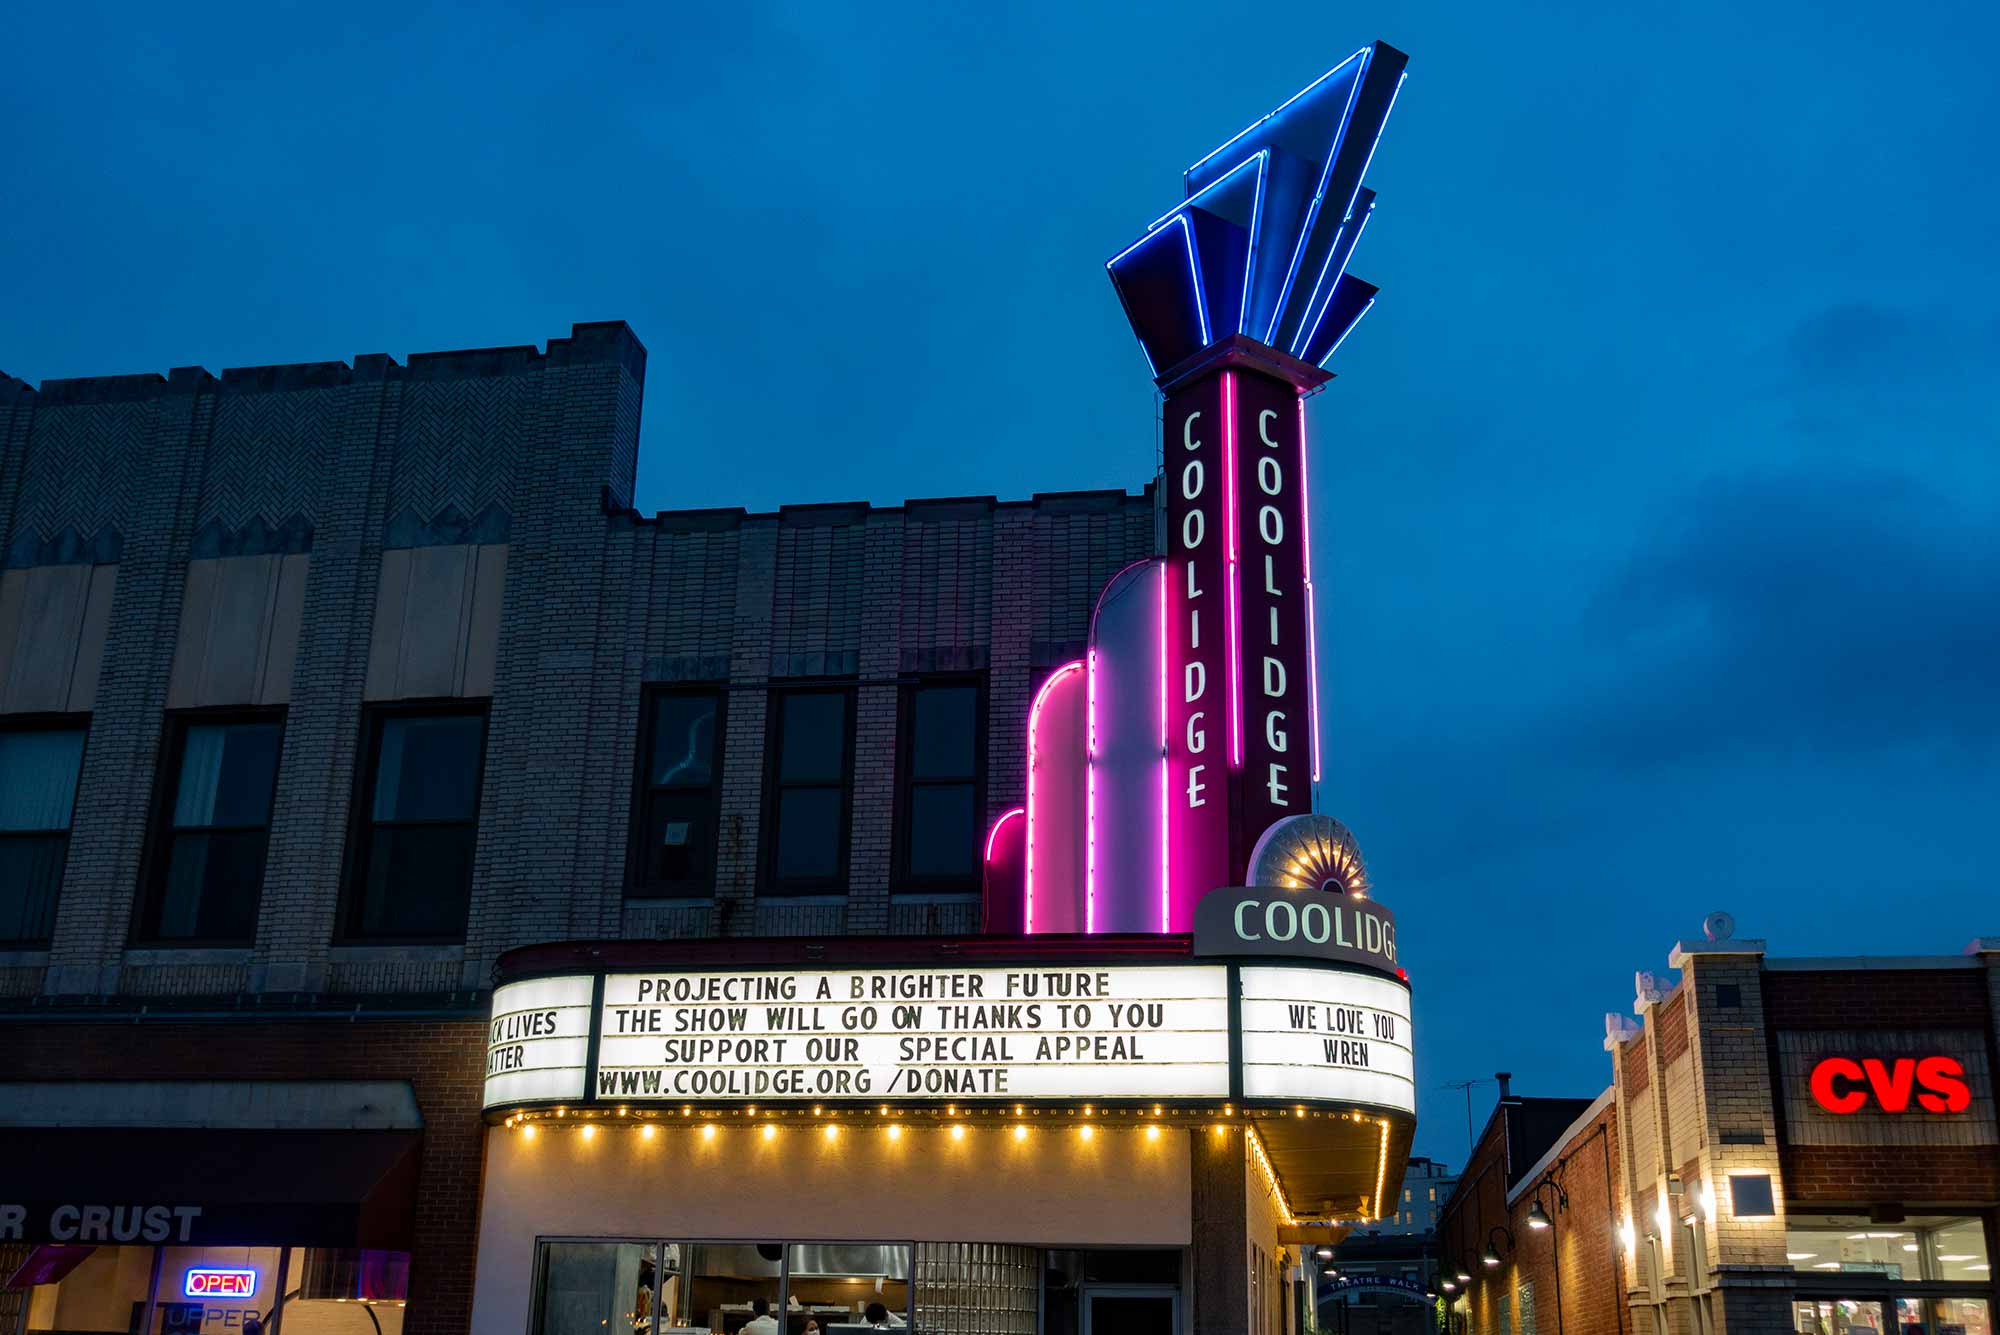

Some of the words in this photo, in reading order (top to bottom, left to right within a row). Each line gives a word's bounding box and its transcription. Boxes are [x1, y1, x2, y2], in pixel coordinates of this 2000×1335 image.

[1182, 411, 1206, 809] COOLIDGE
[1257, 408, 1289, 807] COOLIDGE
[638, 976, 797, 1002] PROJECTING
[816, 976, 832, 1000] A
[850, 974, 984, 999] BRIGHTER
[1006, 973, 1110, 998] FUTURE
[507, 1011, 557, 1040] LIVES
[616, 1009, 662, 1033] THE
[675, 1007, 748, 1032] SHOW
[766, 1007, 825, 1031] WILL
[841, 1006, 878, 1030] GO
[891, 1005, 922, 1030] ON
[937, 1004, 1042, 1029] THANKS
[1057, 1004, 1092, 1029] TO
[1108, 1003, 1164, 1028] YOU
[1288, 1004, 1318, 1030] WE
[1326, 1007, 1365, 1035] LOVE
[1373, 1012, 1396, 1041] YOU
[487, 1045, 524, 1075] ATTER
[664, 1038, 787, 1063] SUPPORT
[805, 1037, 859, 1062] OUR
[899, 1036, 1014, 1061] SPECIAL
[1035, 1035, 1144, 1060] APPEAL
[1323, 1038, 1369, 1067] WREN
[599, 1068, 871, 1096] WWW.COOLIDGE.ORG
[1810, 1056, 1971, 1114] CVS
[50, 1204, 202, 1242] CRUST
[191, 1274, 250, 1293] OPEN
[1331, 1277, 1380, 1291] THEATRE
[1388, 1278, 1419, 1291] WALK
